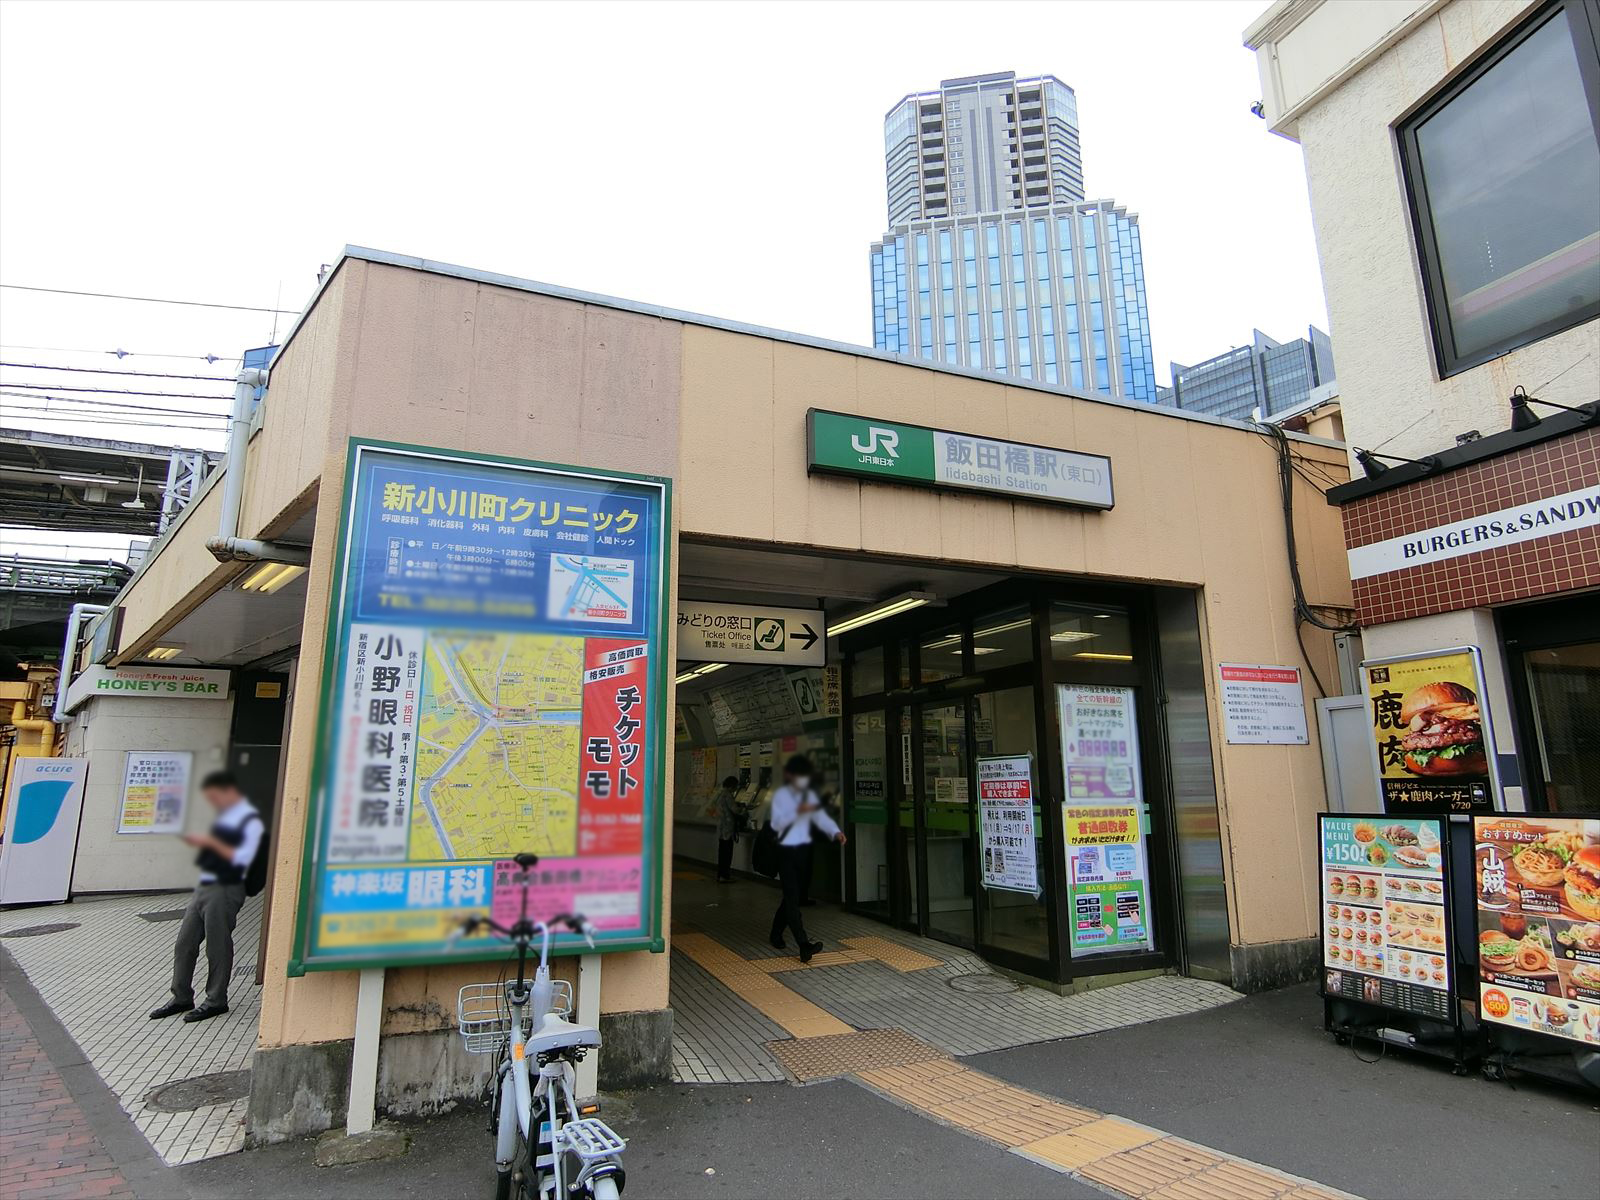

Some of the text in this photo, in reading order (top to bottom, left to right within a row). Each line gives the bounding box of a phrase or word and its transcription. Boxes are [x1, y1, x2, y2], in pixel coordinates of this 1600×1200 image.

[851, 426, 900, 458] JR
[858, 455, 895, 467] JR東日本
[945, 466, 1048, 493] Iidabashi Station
[382, 482, 639, 533] 新小川町クリニック
[381, 513, 635, 546] 呼吸器科 消化器科 外科 内科 皮膚科 会社健診 人間ドック
[701, 630, 752, 641] Ticket Office
[608, 646, 644, 662] 高価買取
[115, 671, 205, 682] Honey&Fresh Juice
[589, 664, 625, 681] 格安販売
[97, 679, 219, 694] HONEY'S BAR
[357, 633, 404, 829] 小野眼科医院
[614, 685, 642, 798] チケット
[35, 764, 73, 774] acure
[585, 736, 613, 798] モモ
[1078, 821, 1129, 835] 普通回数券
[1326, 821, 1352, 831] VALUE
[1326, 831, 1349, 841] MENU
[1482, 829, 1545, 842] おすすめセット
